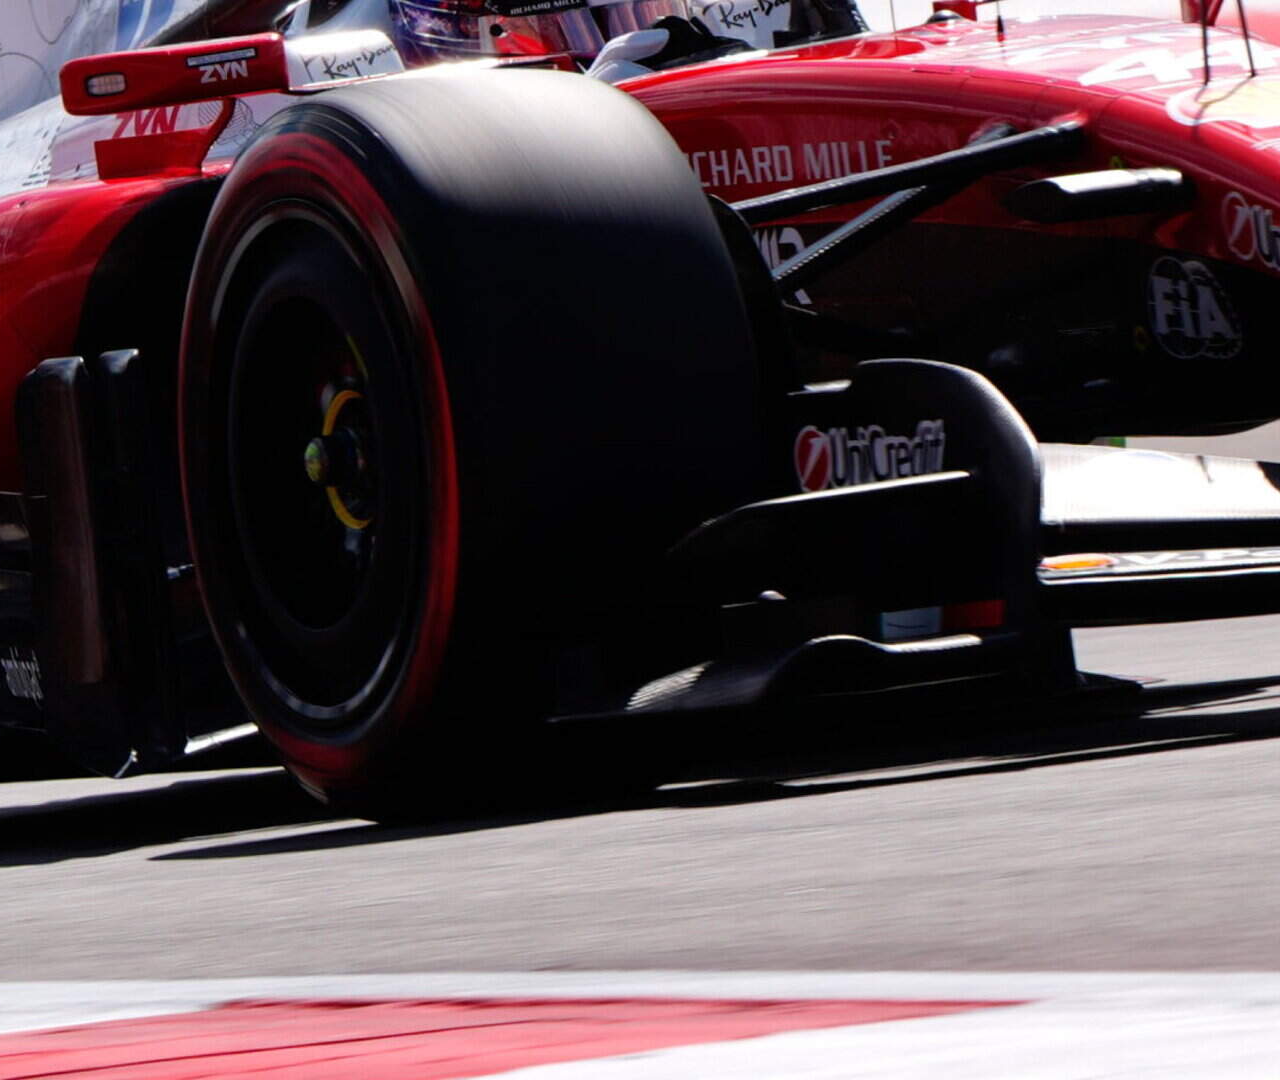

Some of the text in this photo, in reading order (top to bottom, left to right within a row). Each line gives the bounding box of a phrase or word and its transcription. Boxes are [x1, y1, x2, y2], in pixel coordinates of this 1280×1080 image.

[199, 60, 249, 84] ZYN
[688, 144, 793, 188] CHARD
[827, 420, 945, 487] UniCredit
